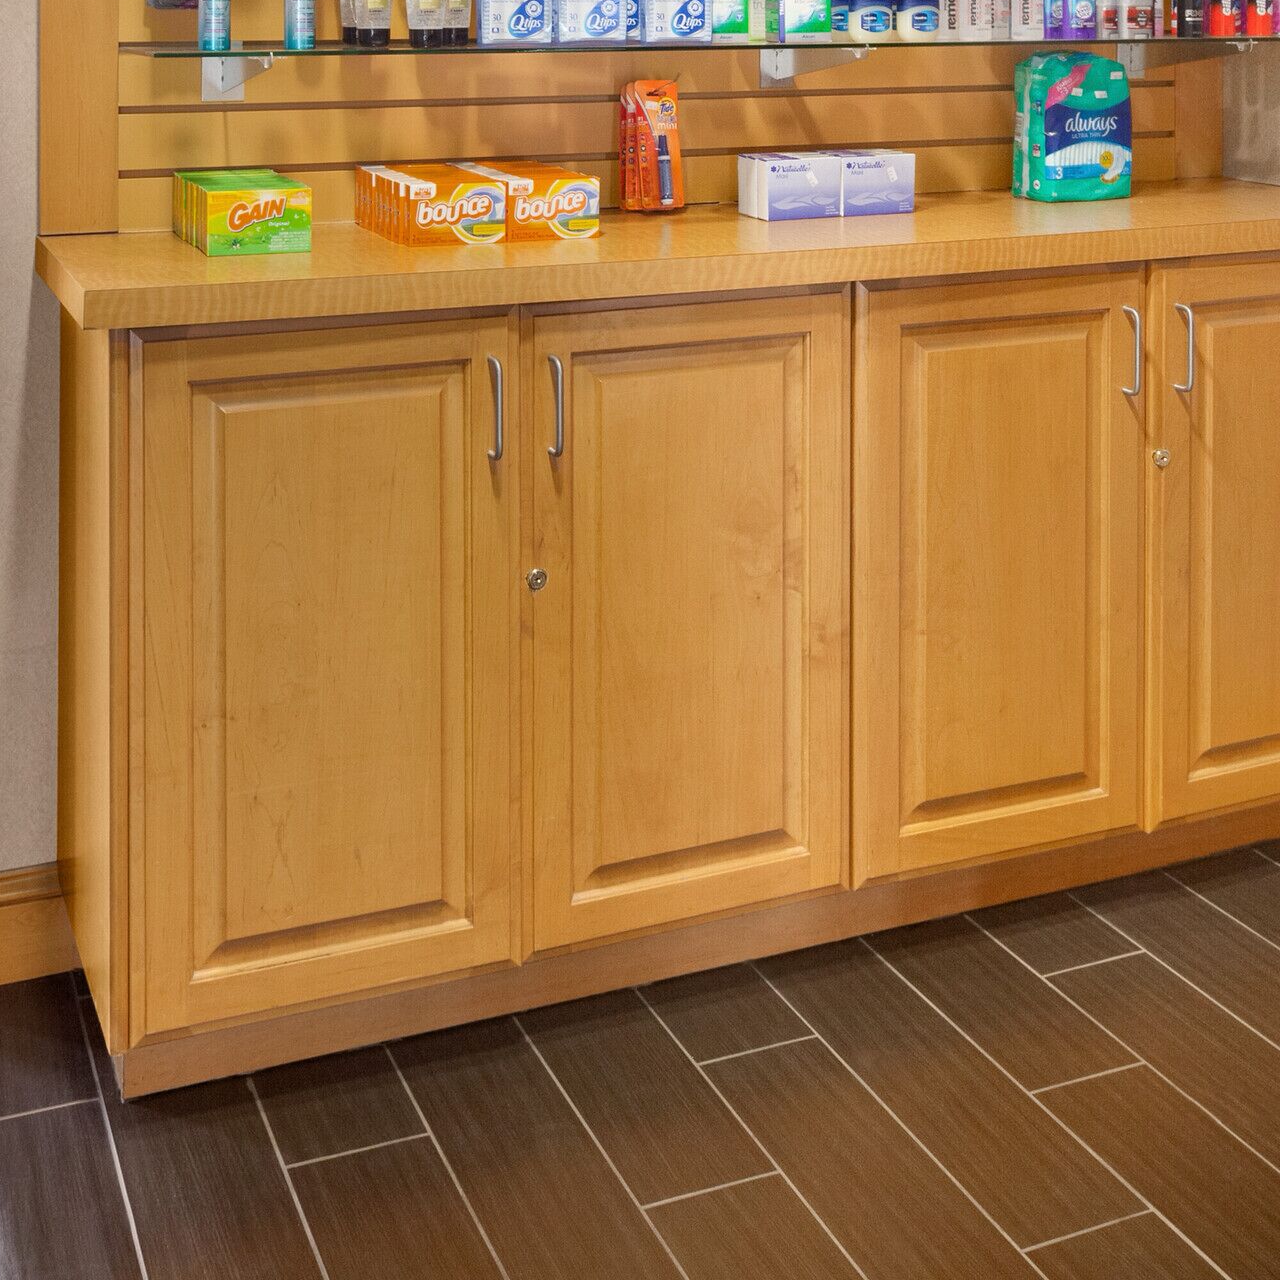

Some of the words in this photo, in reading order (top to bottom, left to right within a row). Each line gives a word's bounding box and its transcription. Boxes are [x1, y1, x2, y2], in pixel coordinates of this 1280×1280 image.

[660, 103, 674, 114] Tide
[1065, 112, 1118, 137] always
[227, 197, 287, 232] GAIN
[417, 196, 493, 227] bounce
[515, 192, 588, 224] bounce
